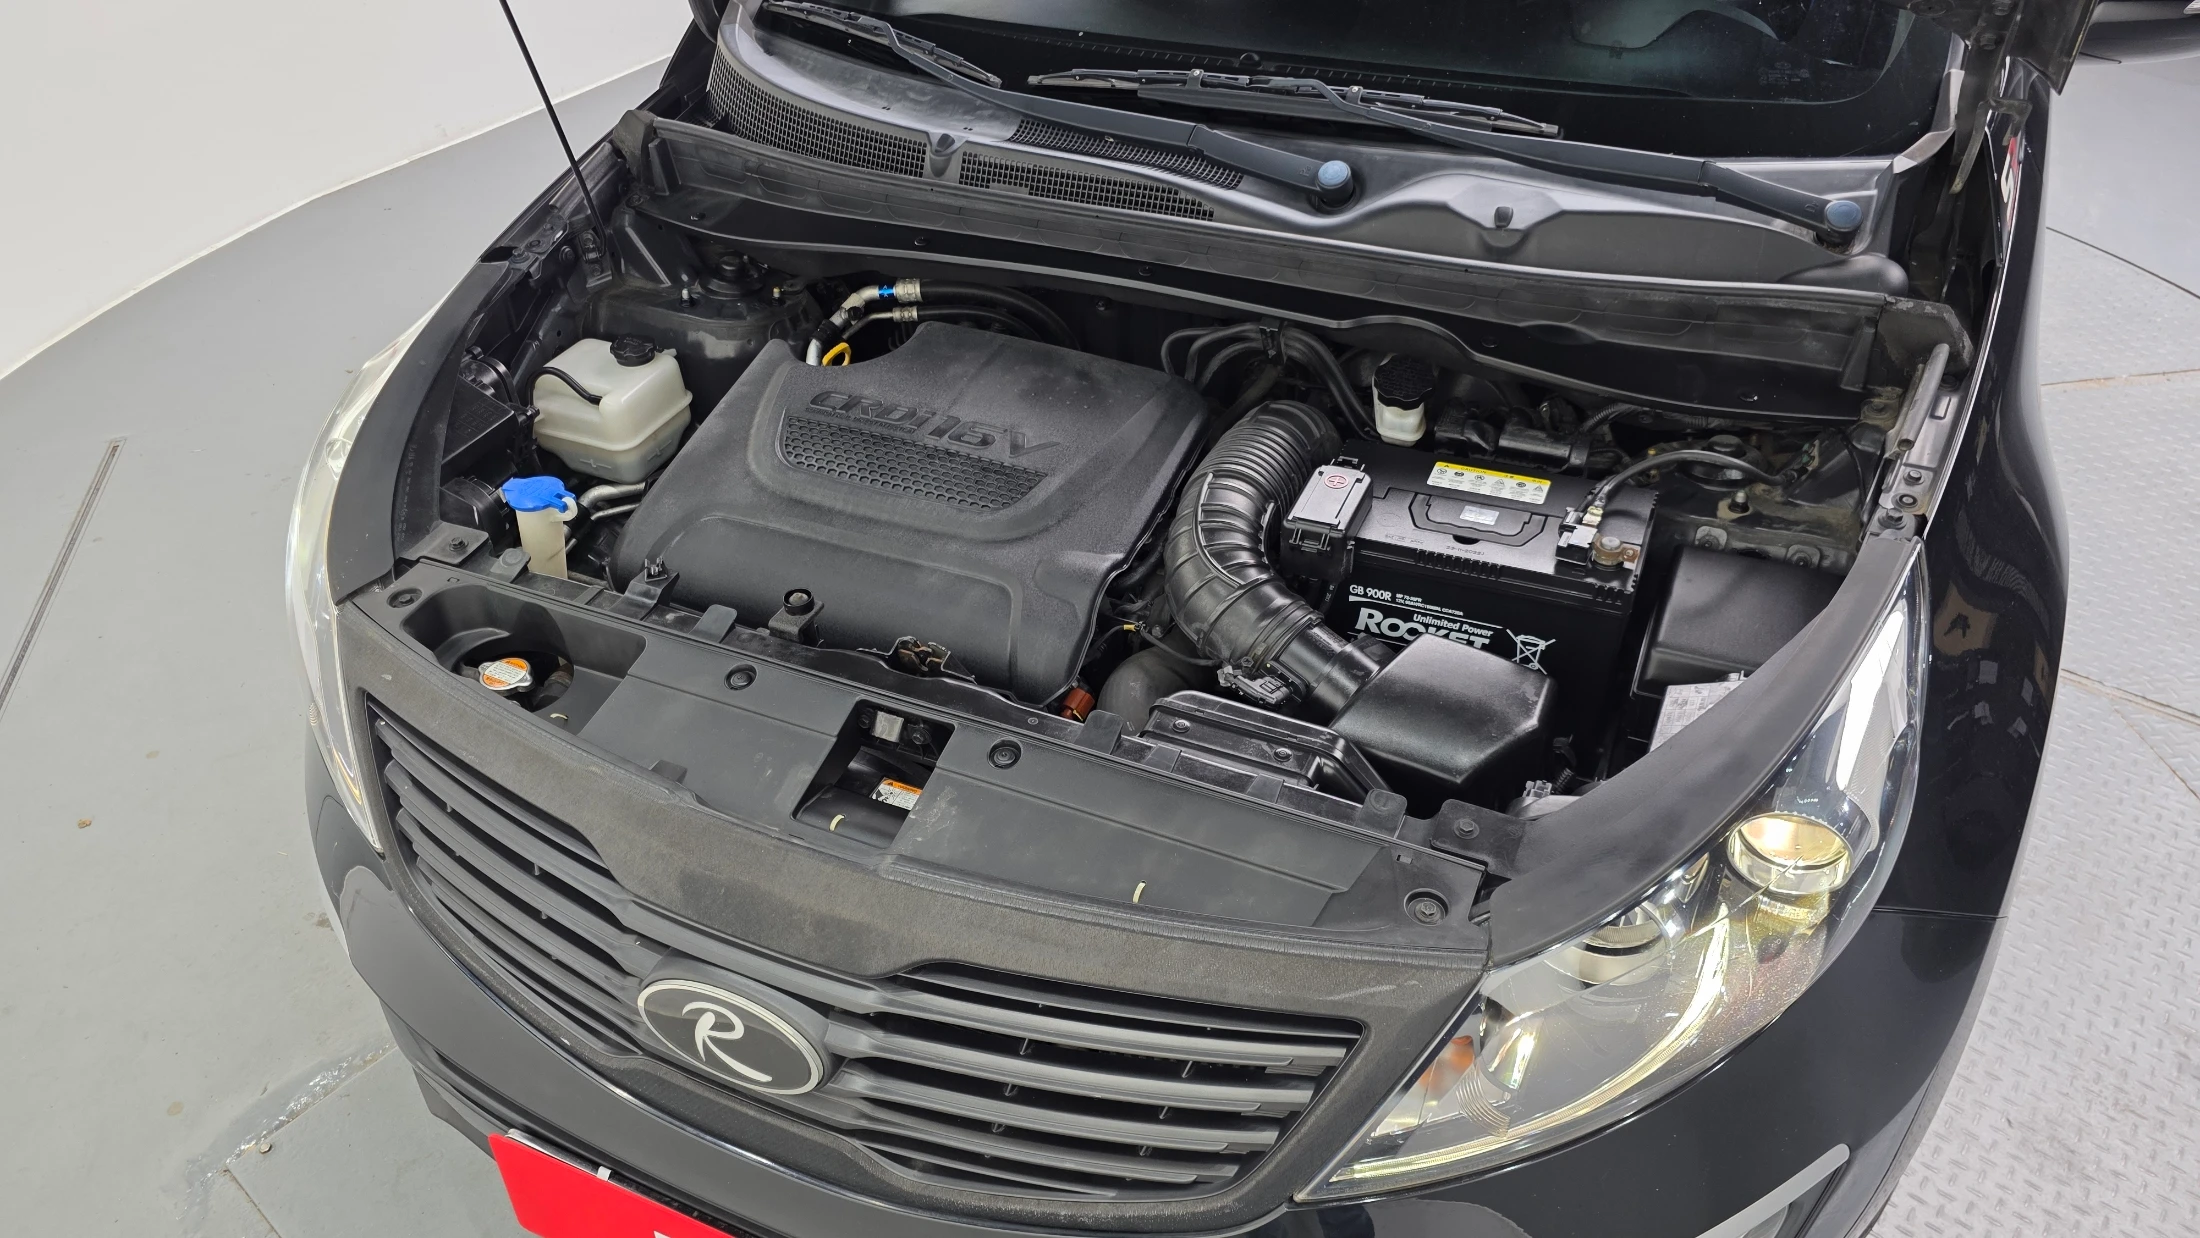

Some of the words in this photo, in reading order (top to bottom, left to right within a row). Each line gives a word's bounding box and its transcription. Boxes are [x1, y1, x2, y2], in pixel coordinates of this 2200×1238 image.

[1349, 584, 1364, 595] GB
[1366, 588, 1392, 601] 900R
[1413, 613, 1460, 631] Unlimited
[1461, 623, 1494, 638] Power
[682, 1001, 773, 1082] R
